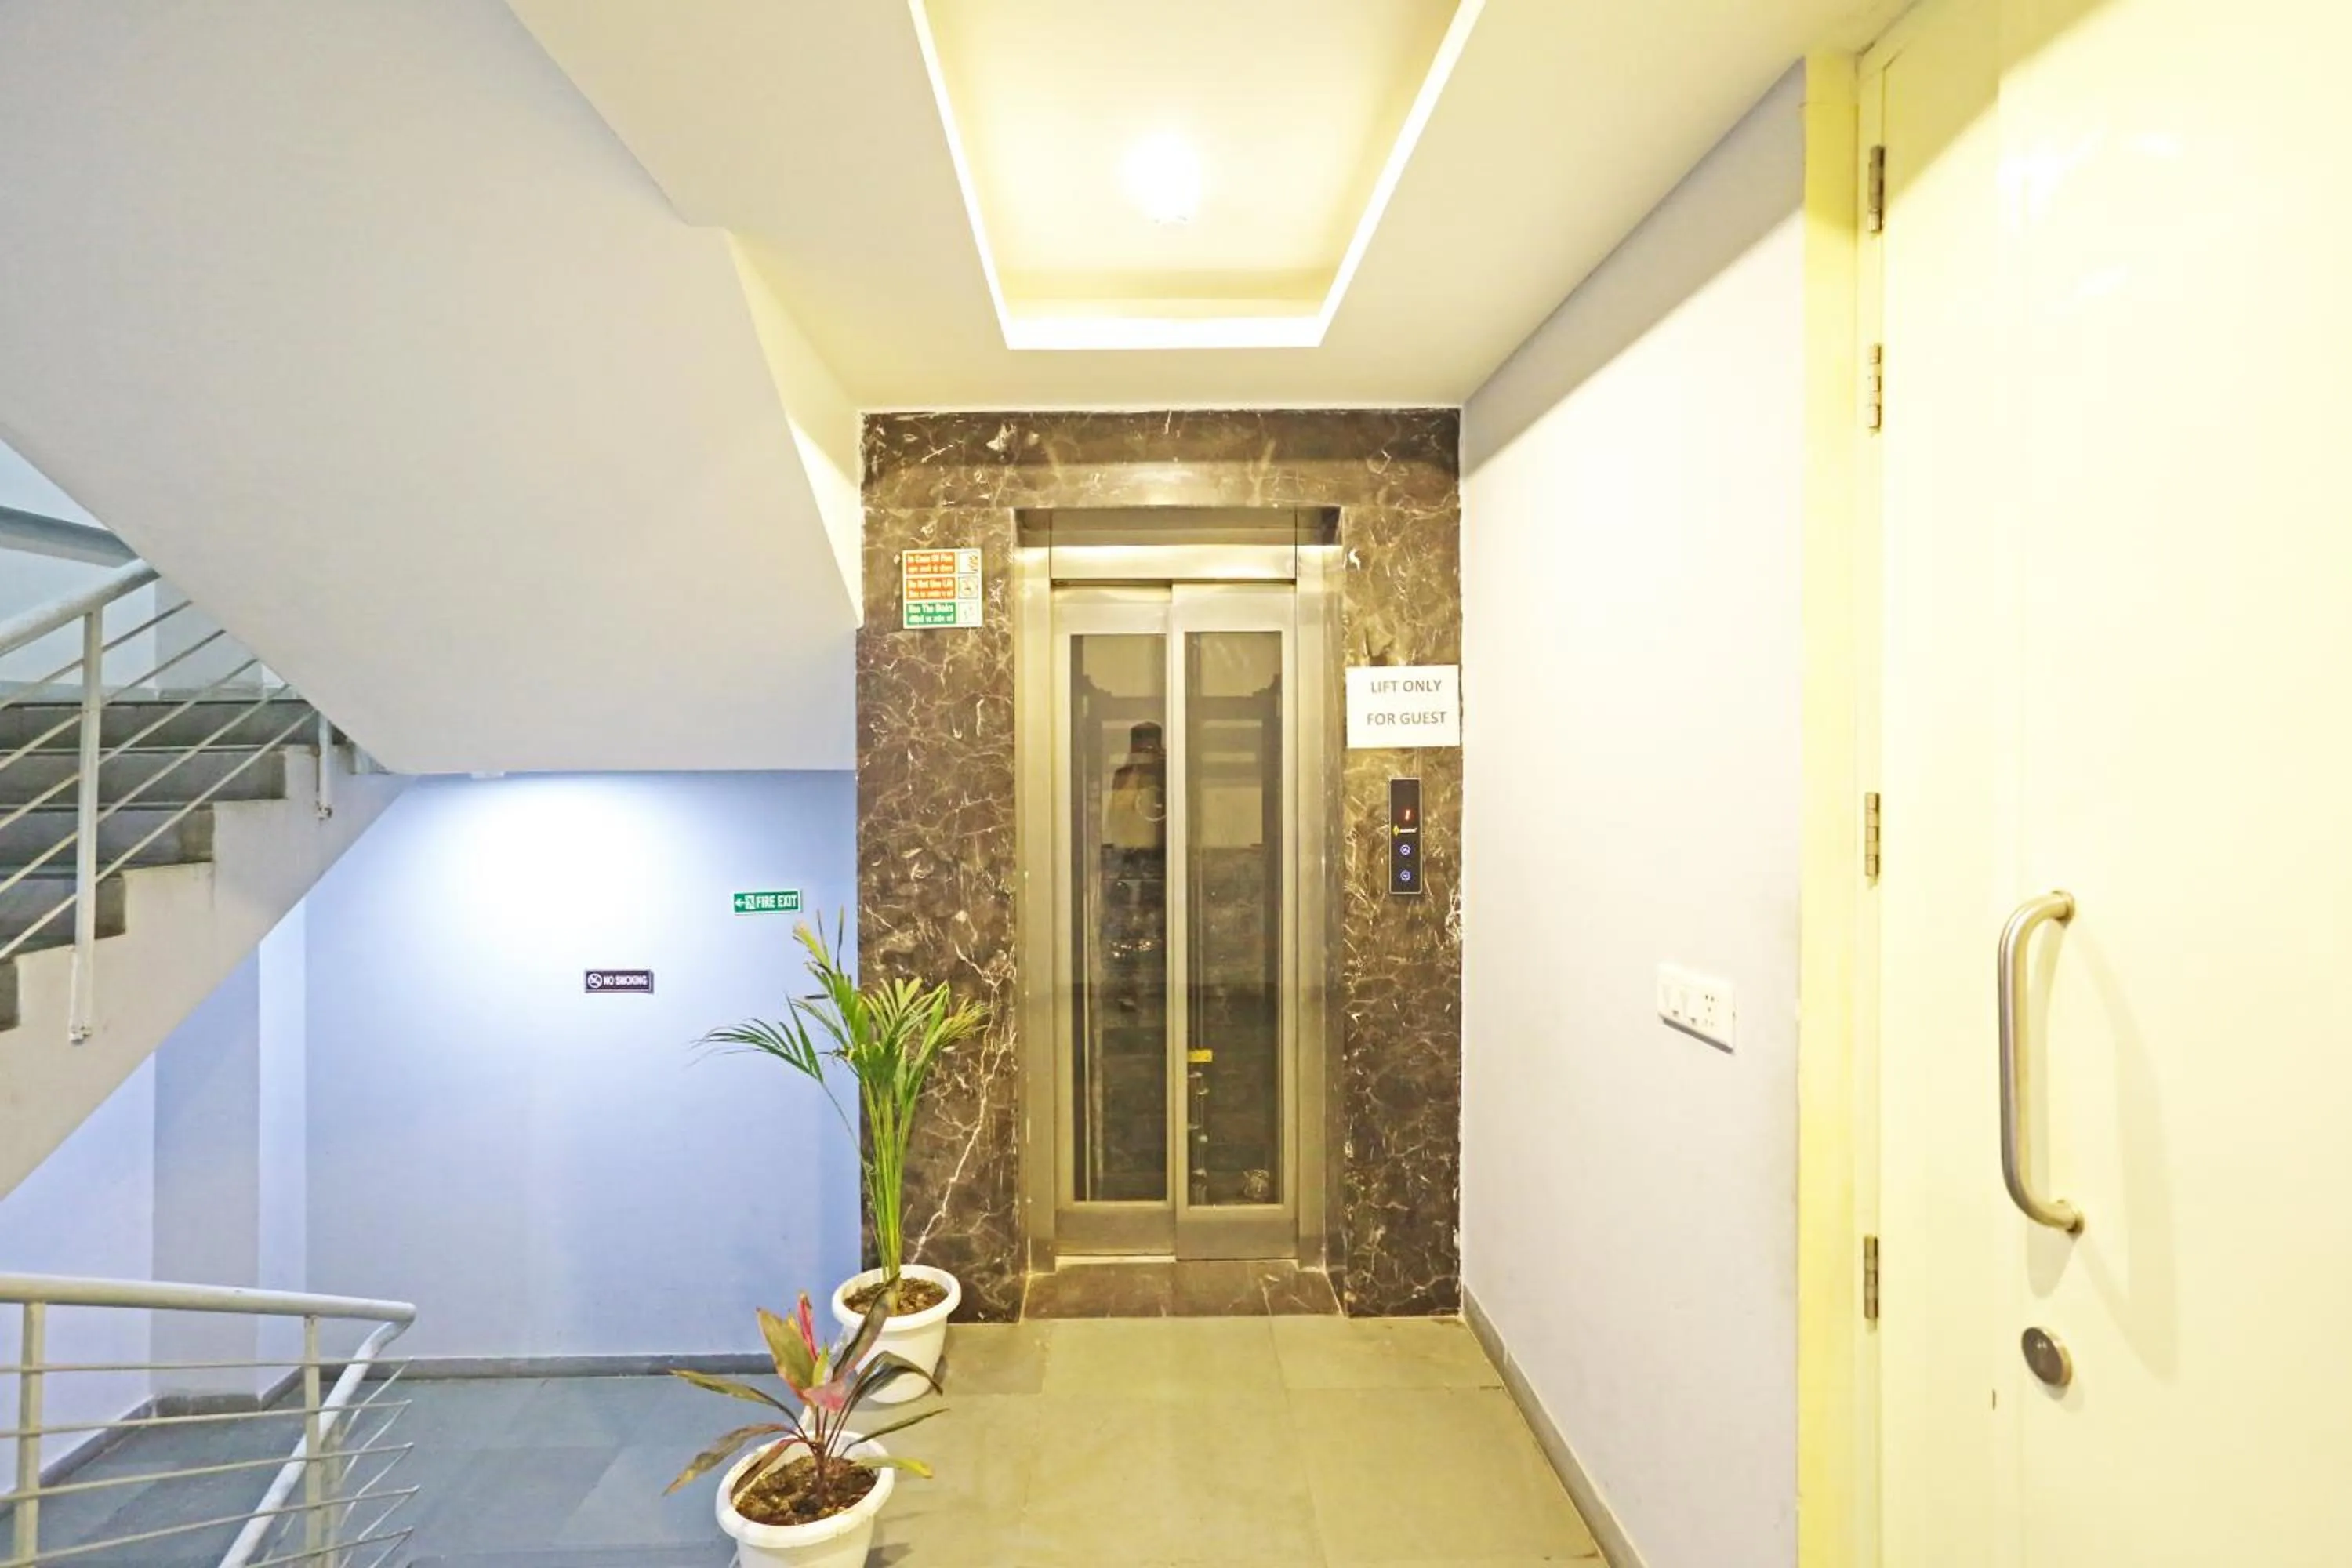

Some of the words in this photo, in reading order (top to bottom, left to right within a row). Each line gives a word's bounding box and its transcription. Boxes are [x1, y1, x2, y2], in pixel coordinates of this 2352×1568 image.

[1370, 681, 1399, 693] LIFT
[1403, 679, 1442, 692] ONLY
[1367, 713, 1396, 725] FOR
[1400, 711, 1447, 725] GUEST
[756, 895, 775, 908] FIRE
[777, 895, 797, 907] EXIT
[603, 975, 615, 985] NO
[615, 975, 648, 985] SMOKING
